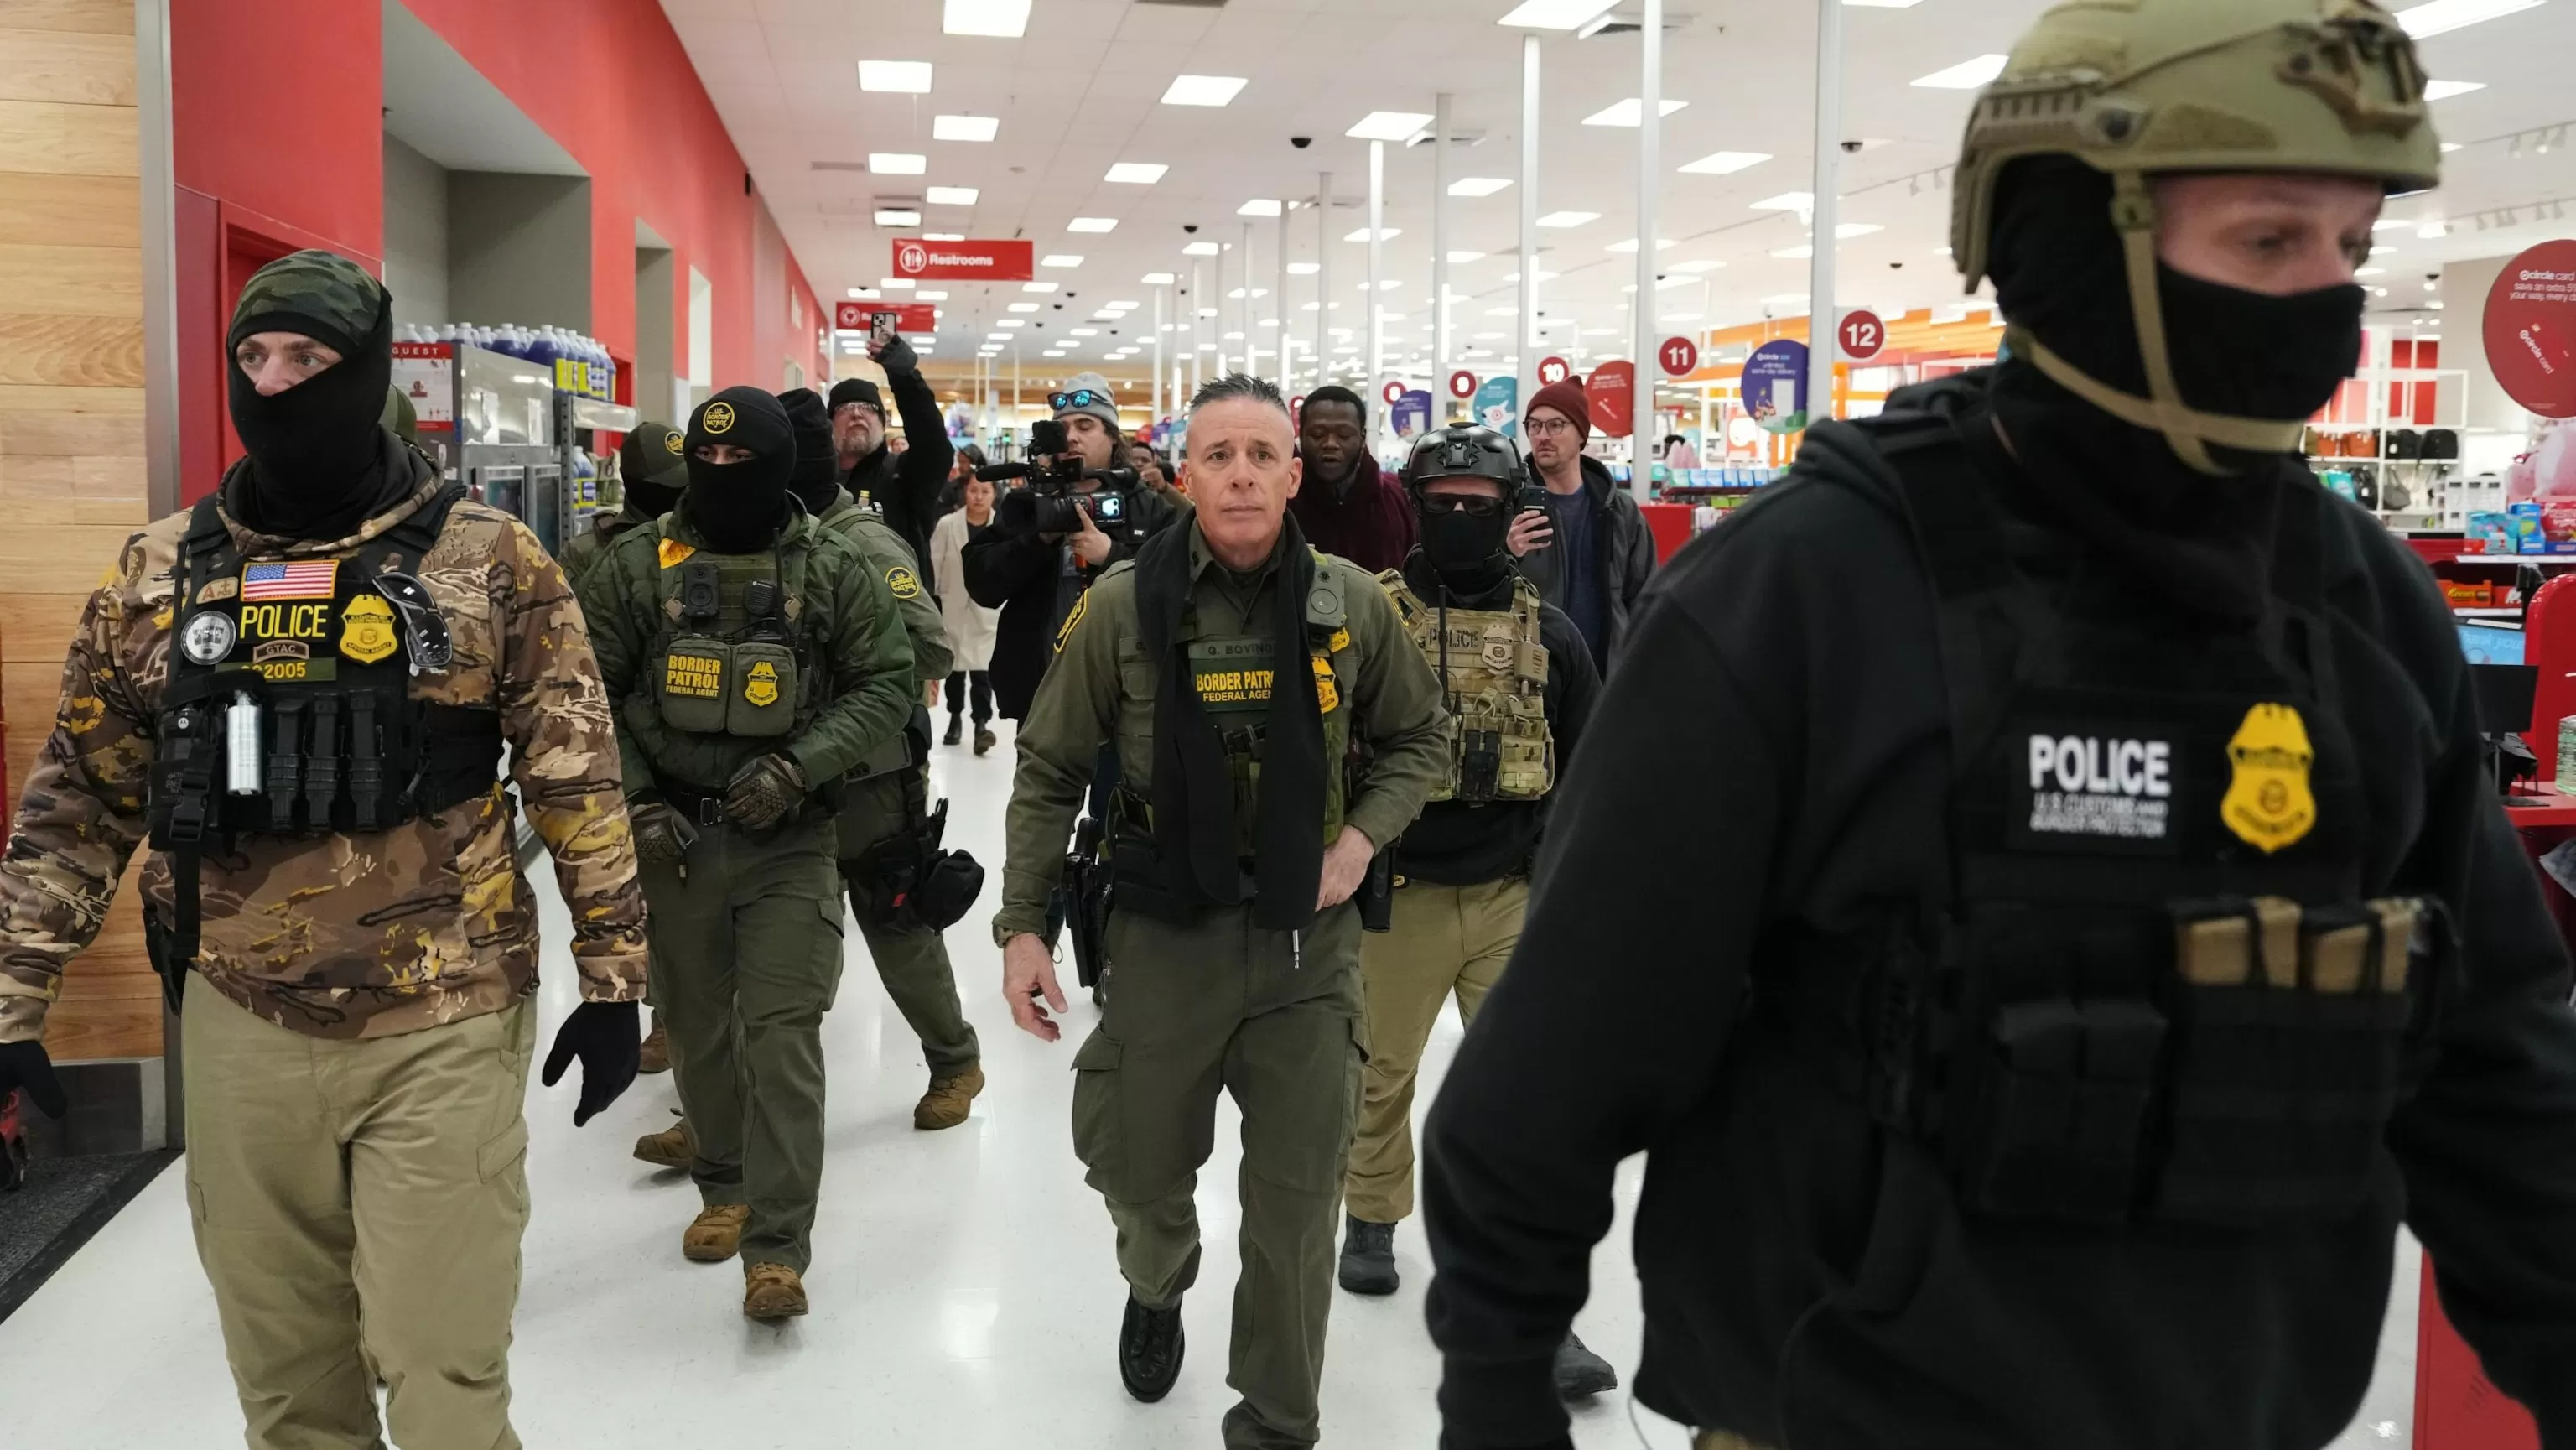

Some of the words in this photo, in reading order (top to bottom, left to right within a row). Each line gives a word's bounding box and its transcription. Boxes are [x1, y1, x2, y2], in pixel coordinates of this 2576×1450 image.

[929, 254, 994, 266] Restrooms
[2556, 272, 2575, 281] card
[2514, 283, 2532, 291] save
[2509, 292, 2526, 300] your
[2546, 294, 2567, 303] every
[1846, 323, 1877, 347] 12
[1668, 346, 1689, 366] 11
[1543, 363, 1565, 382] 10
[1457, 376, 1470, 393] 9
[1389, 386, 1402, 401] 8
[240, 605, 329, 639] POLICE
[1429, 627, 1479, 648] PLICE
[267, 644, 296, 655] GTAC
[242, 662, 307, 679] 2005
[668, 655, 721, 674] BORDER
[667, 670, 719, 689] PATROL
[1197, 672, 1242, 691] BORDER
[666, 685, 694, 695] FEDERAL
[696, 688, 719, 697] AGENT
[1203, 691, 1247, 702] FEDERAL
[2029, 734, 2171, 797] POLICE
